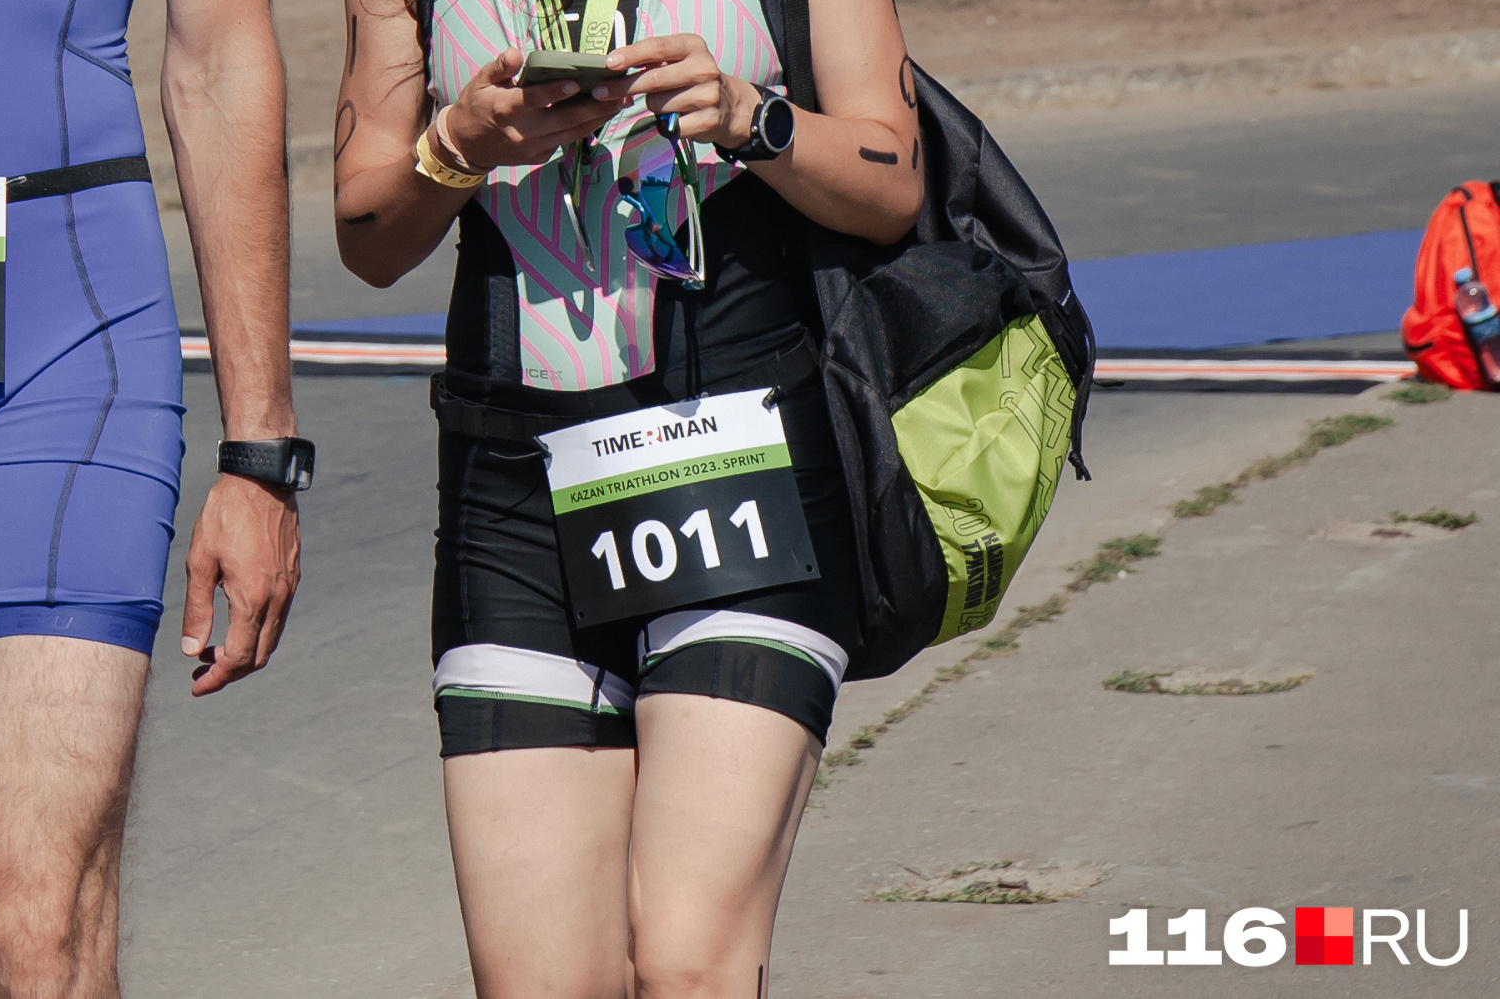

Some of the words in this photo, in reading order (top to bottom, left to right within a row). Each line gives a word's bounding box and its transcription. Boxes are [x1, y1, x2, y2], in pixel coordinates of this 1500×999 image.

[570, 485, 606, 503] KAZAN
[606, 468, 680, 494] TRIATHLON
[683, 460, 722, 478] 2023.
[722, 452, 767, 470] SPRINT
[941, 497, 991, 536] 20
[590, 499, 770, 591] 1011
